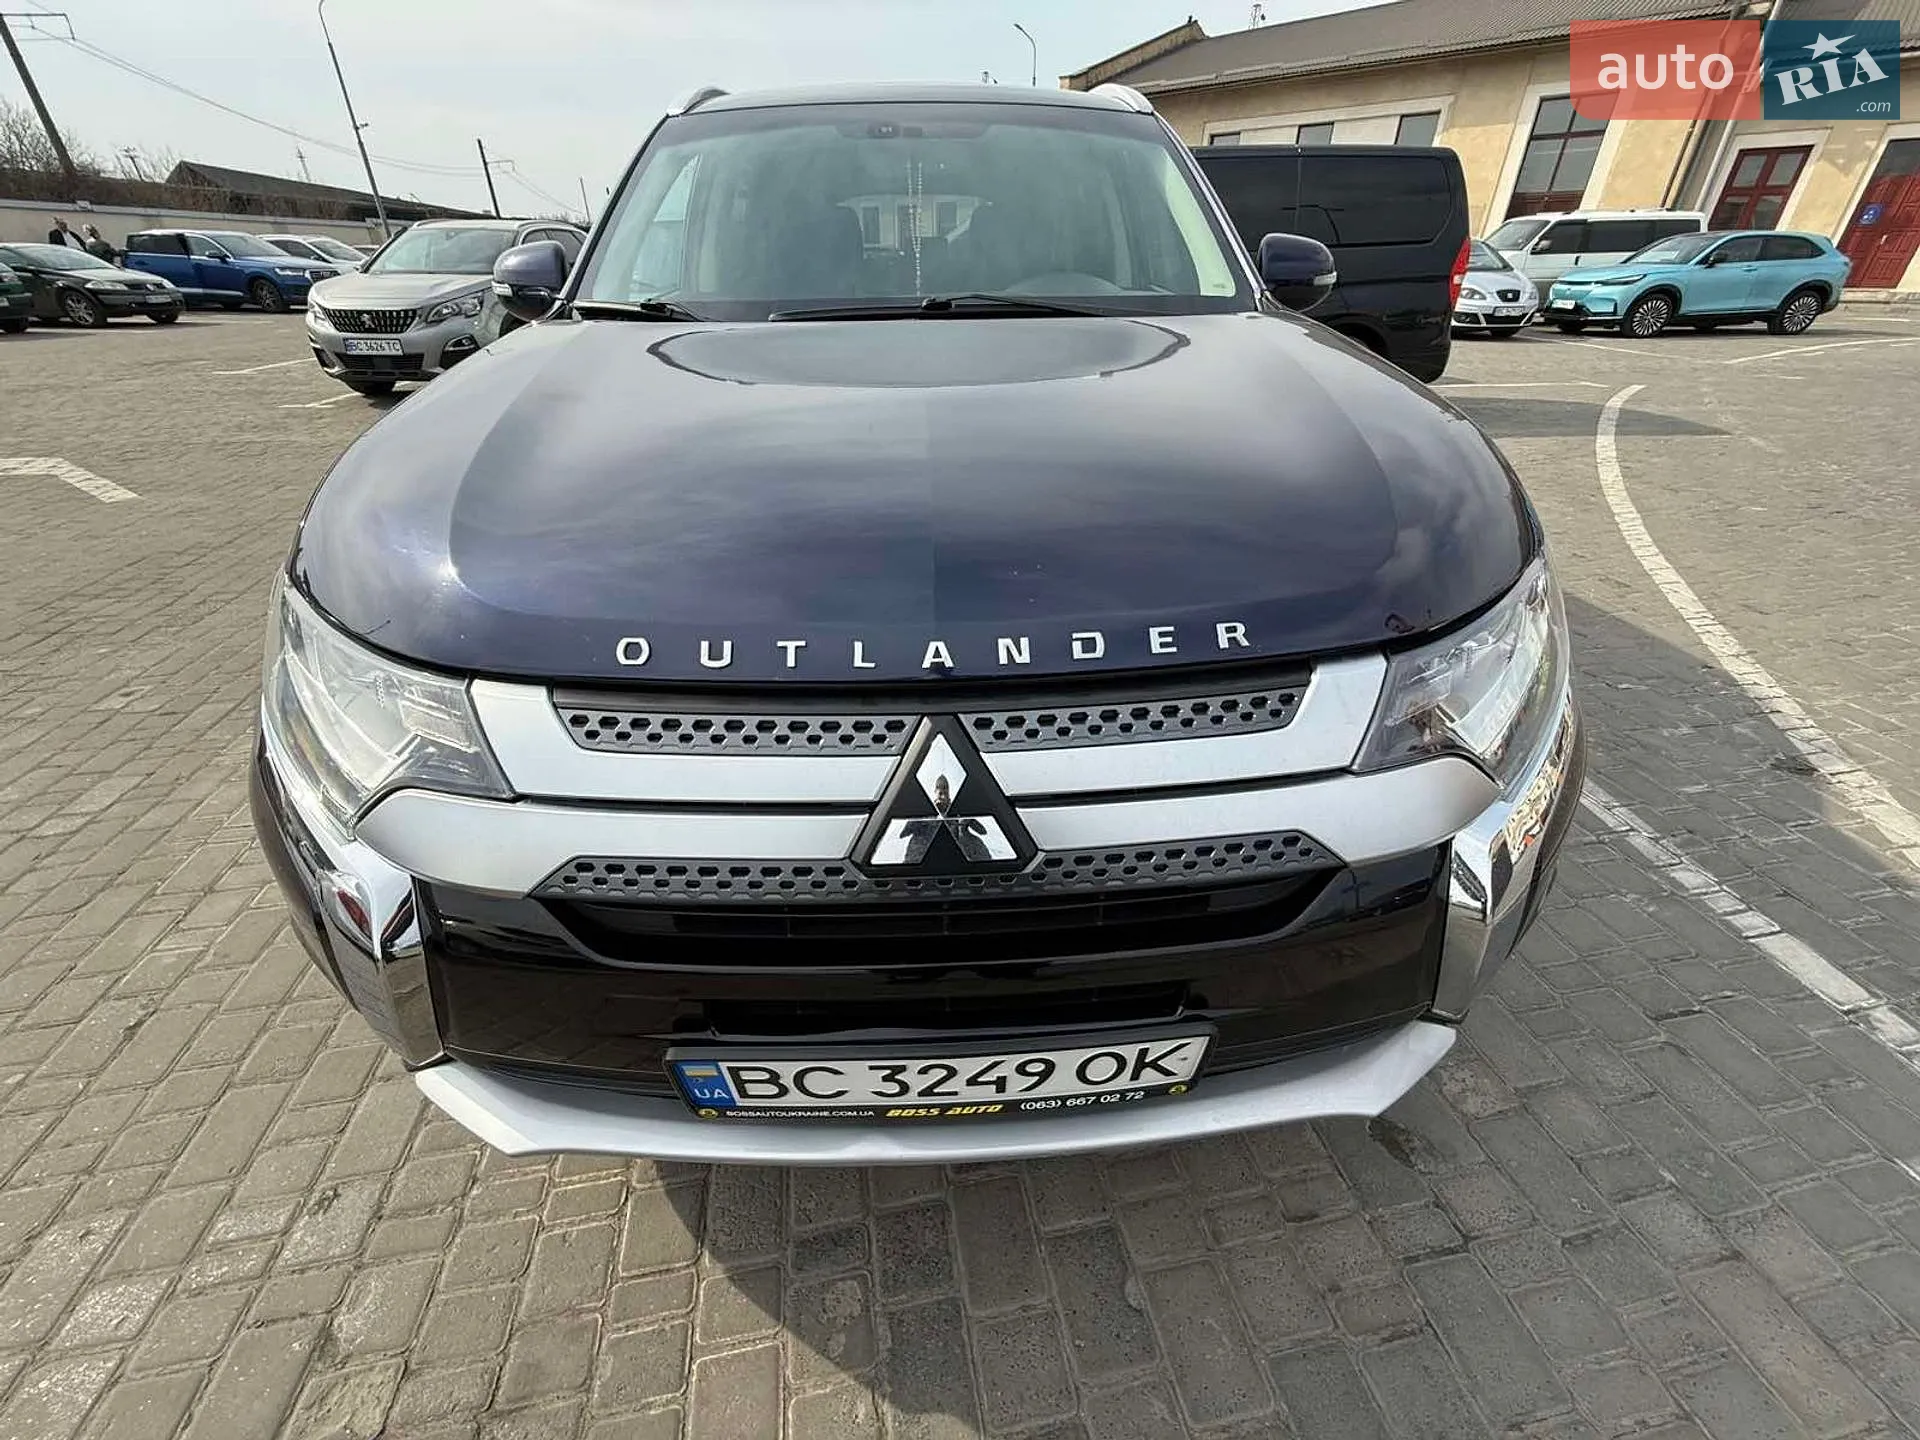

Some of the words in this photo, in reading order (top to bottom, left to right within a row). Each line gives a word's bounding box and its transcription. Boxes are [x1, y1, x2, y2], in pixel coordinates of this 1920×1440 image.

[615, 622, 1250, 669] OUTLANDER
[727, 1065, 848, 1099] BC
[868, 1058, 1056, 1098] 3249
[1076, 1042, 1191, 1086] OK
[694, 1088, 729, 1099] UA
[886, 1107, 941, 1117] BOSS
[1020, 1100, 1062, 1110] (063)
[1066, 1097, 1097, 1106] 667
[1100, 1092, 1125, 1103] 02
[1125, 1091, 1145, 1100] 72
